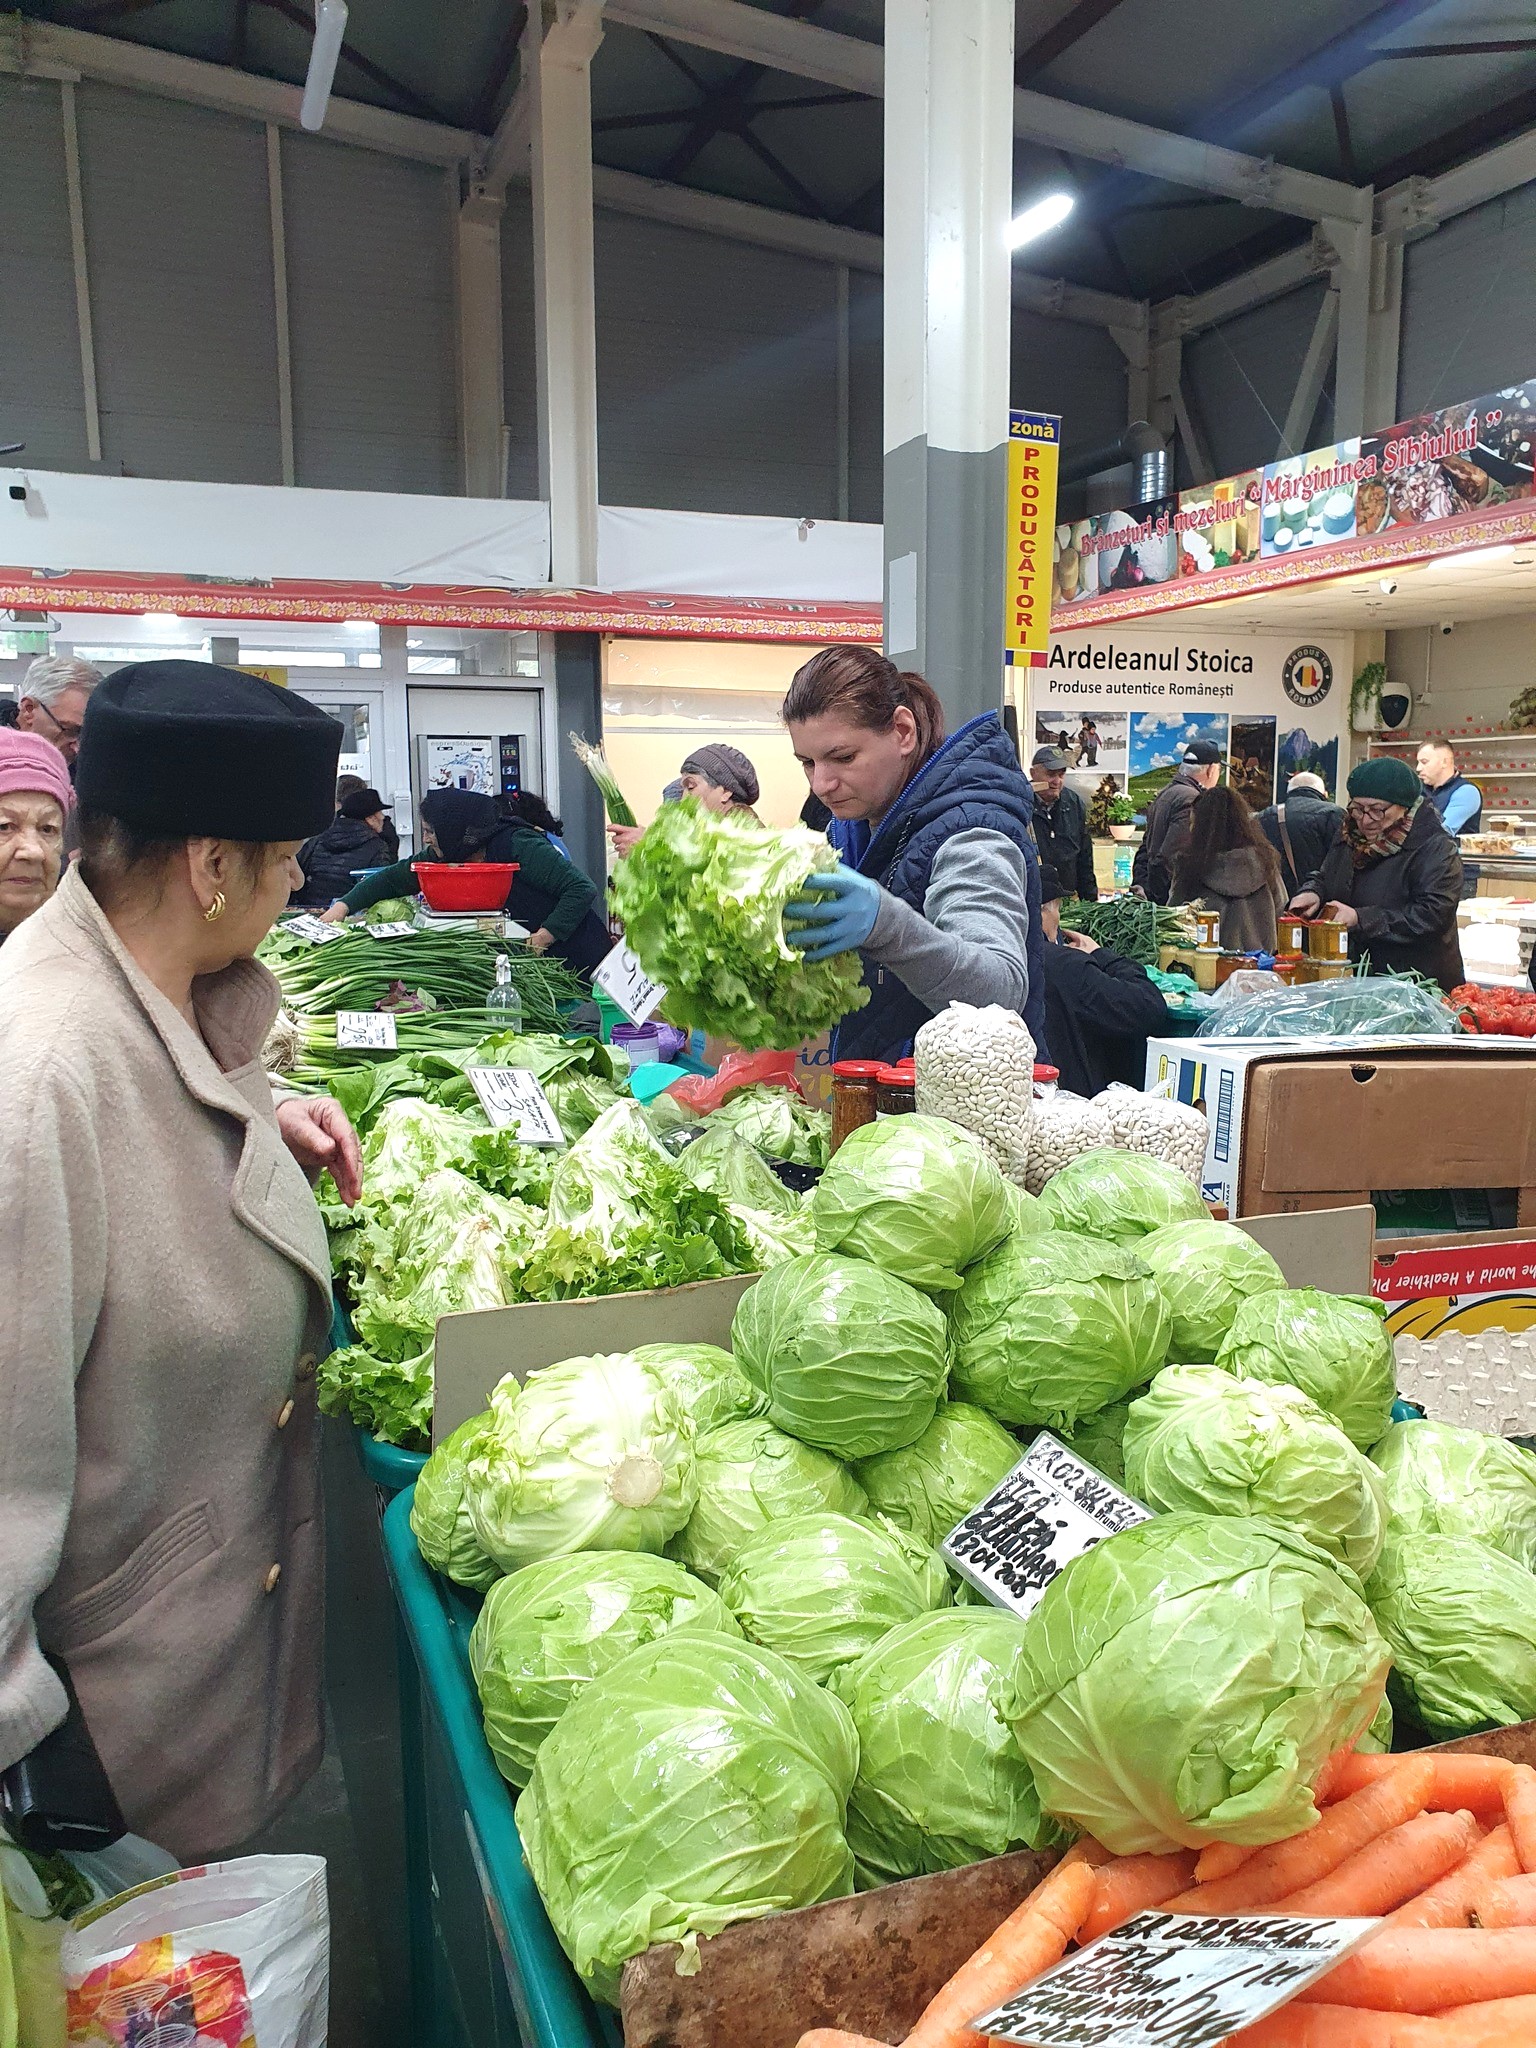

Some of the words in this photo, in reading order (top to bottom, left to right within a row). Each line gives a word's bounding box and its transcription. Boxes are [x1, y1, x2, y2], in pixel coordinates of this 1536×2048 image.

[1011, 420, 1055, 440] zonă
[1081, 514, 1153, 558] Brânzeturi
[1173, 490, 1246, 533] mezeluri
[1015, 447, 1041, 645] PRODUCĂTORI
[1048, 643, 1180, 672] Ardeleanul
[1185, 647, 1254, 674] Stoica
[1287, 648, 1320, 667] PRODUS
[1049, 680, 1102, 694] Produse
[1105, 681, 1165, 695] autentice
[1168, 682, 1234, 699] Românești
[1395, 1271, 1460, 1292] Healthier
[1465, 1272, 1476, 1285] A
[1479, 1265, 1517, 1285] World
